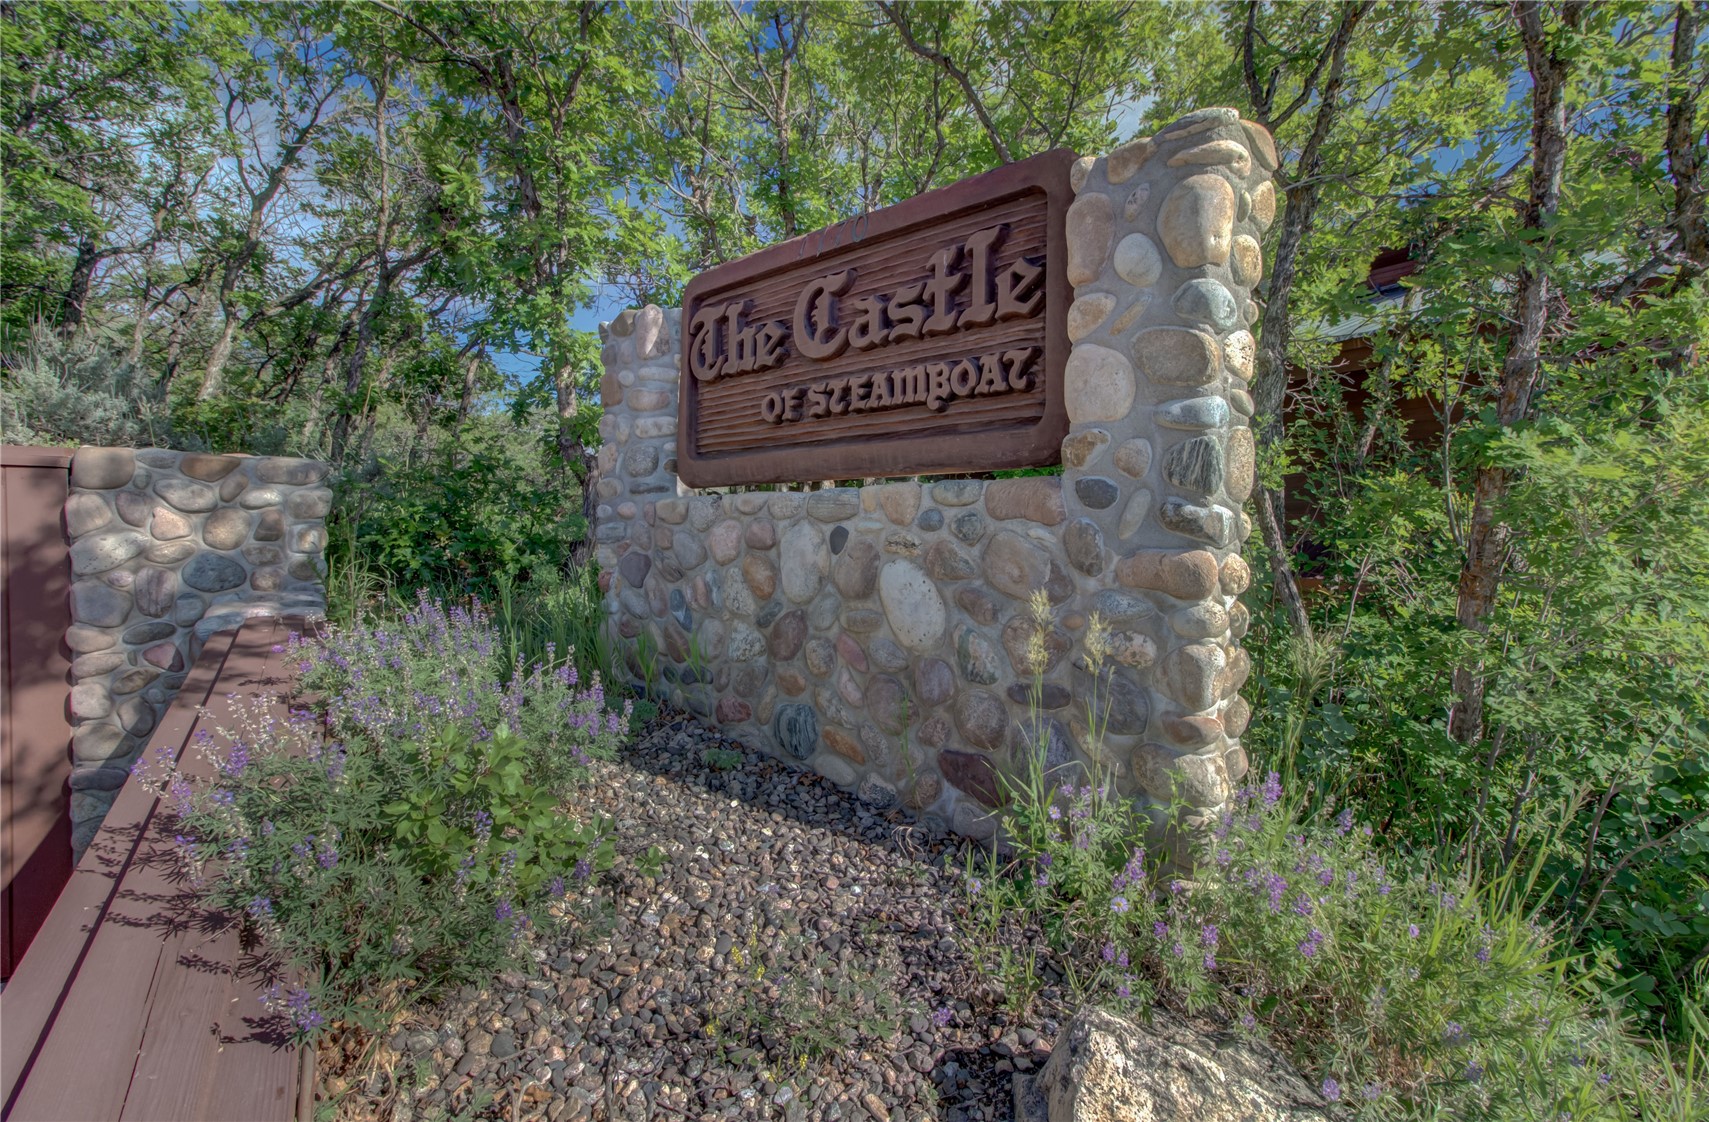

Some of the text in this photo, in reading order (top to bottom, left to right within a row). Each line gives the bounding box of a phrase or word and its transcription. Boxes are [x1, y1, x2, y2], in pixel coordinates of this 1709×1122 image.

[689, 224, 1044, 382] The Castle
[761, 347, 1037, 424] OF STEAMBOAT
